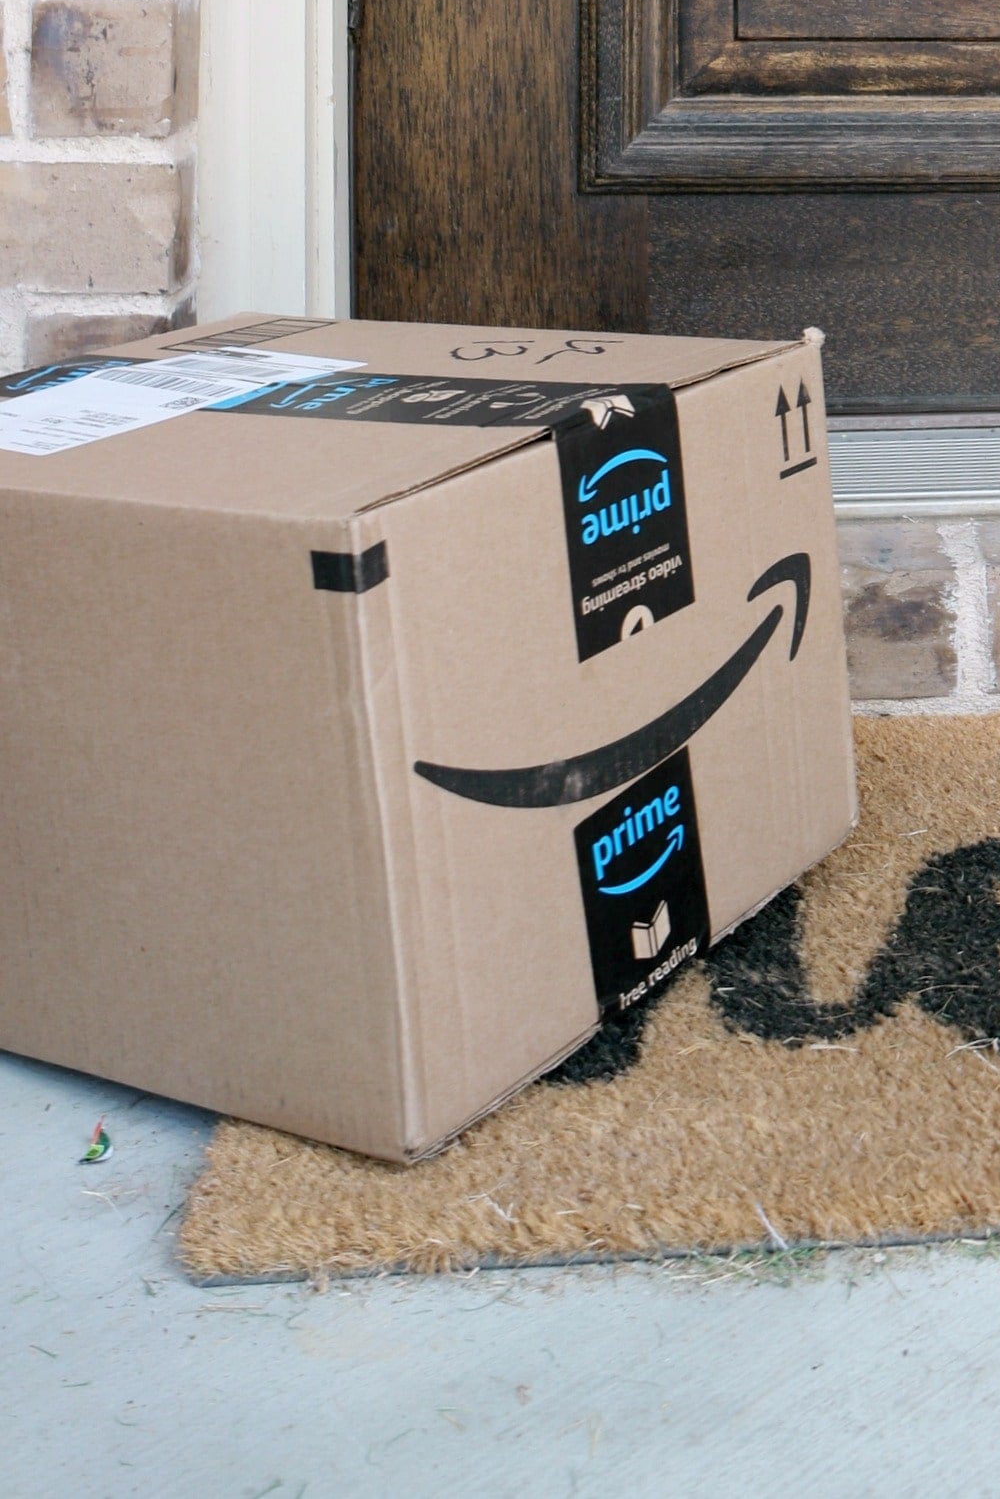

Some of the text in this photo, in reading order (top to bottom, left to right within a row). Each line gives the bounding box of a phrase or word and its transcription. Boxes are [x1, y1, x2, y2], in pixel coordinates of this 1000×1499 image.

[581, 469, 672, 545] prime
[581, 554, 683, 615] video streaming
[618, 564, 627, 575] tv
[627, 556, 642, 572] and
[592, 785, 681, 881] prime
[618, 936, 698, 1010] free reading
